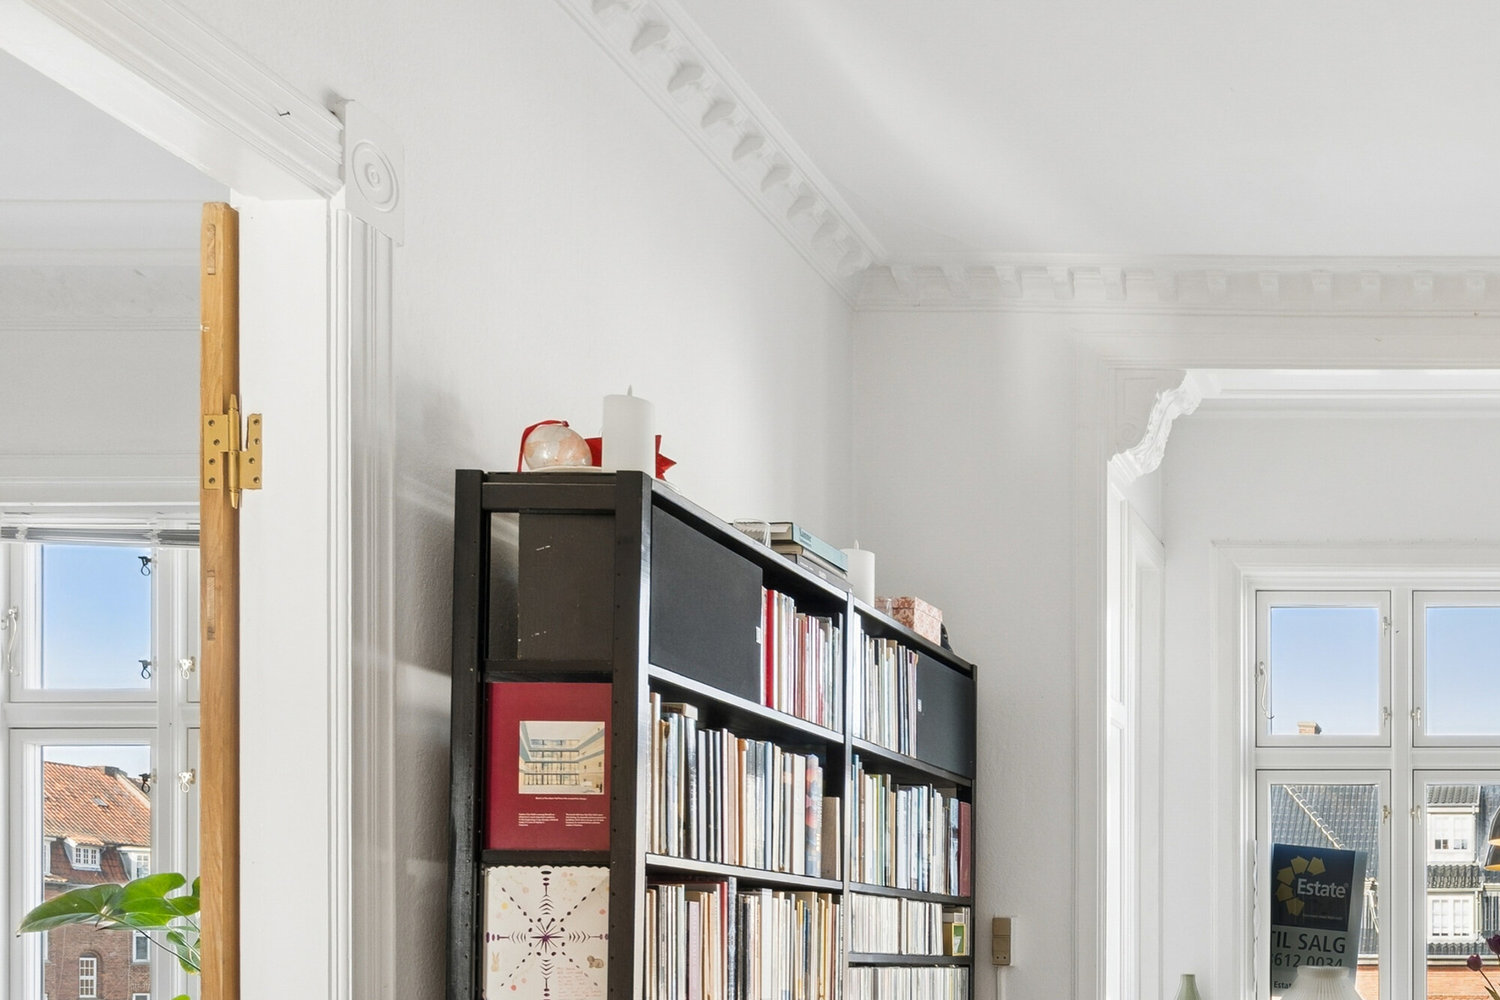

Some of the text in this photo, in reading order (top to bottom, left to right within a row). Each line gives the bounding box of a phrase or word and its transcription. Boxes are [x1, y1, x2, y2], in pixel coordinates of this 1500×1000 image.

[1297, 878, 1346, 898] Estate
[1298, 933, 1345, 953] SALG
[1272, 953, 1301, 967] 612
